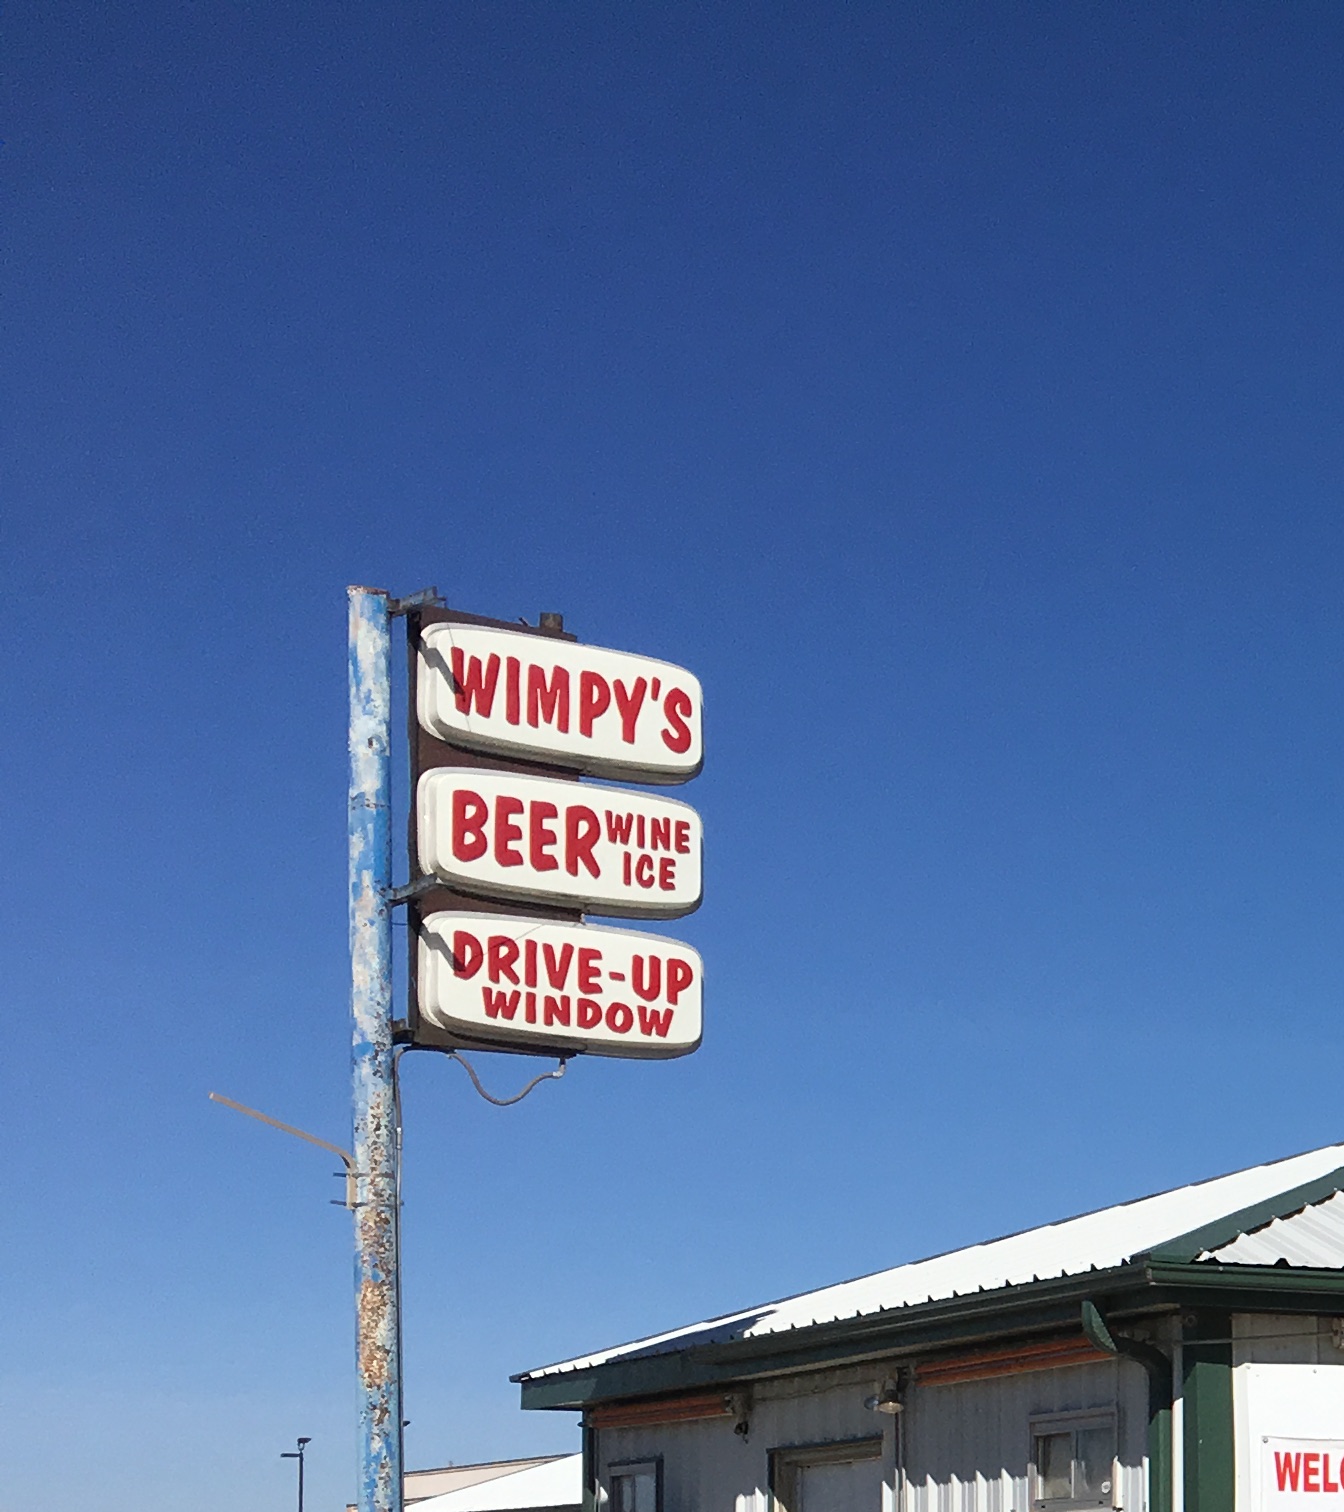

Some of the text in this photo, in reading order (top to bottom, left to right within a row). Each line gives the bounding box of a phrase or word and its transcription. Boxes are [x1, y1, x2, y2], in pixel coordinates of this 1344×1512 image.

[451, 647, 693, 754] WIMPY'S
[452, 789, 691, 879] BEER WINE
[623, 854, 677, 891] ICE
[453, 930, 693, 1005] DRIVE-UP
[482, 986, 674, 1038] WINDOW
